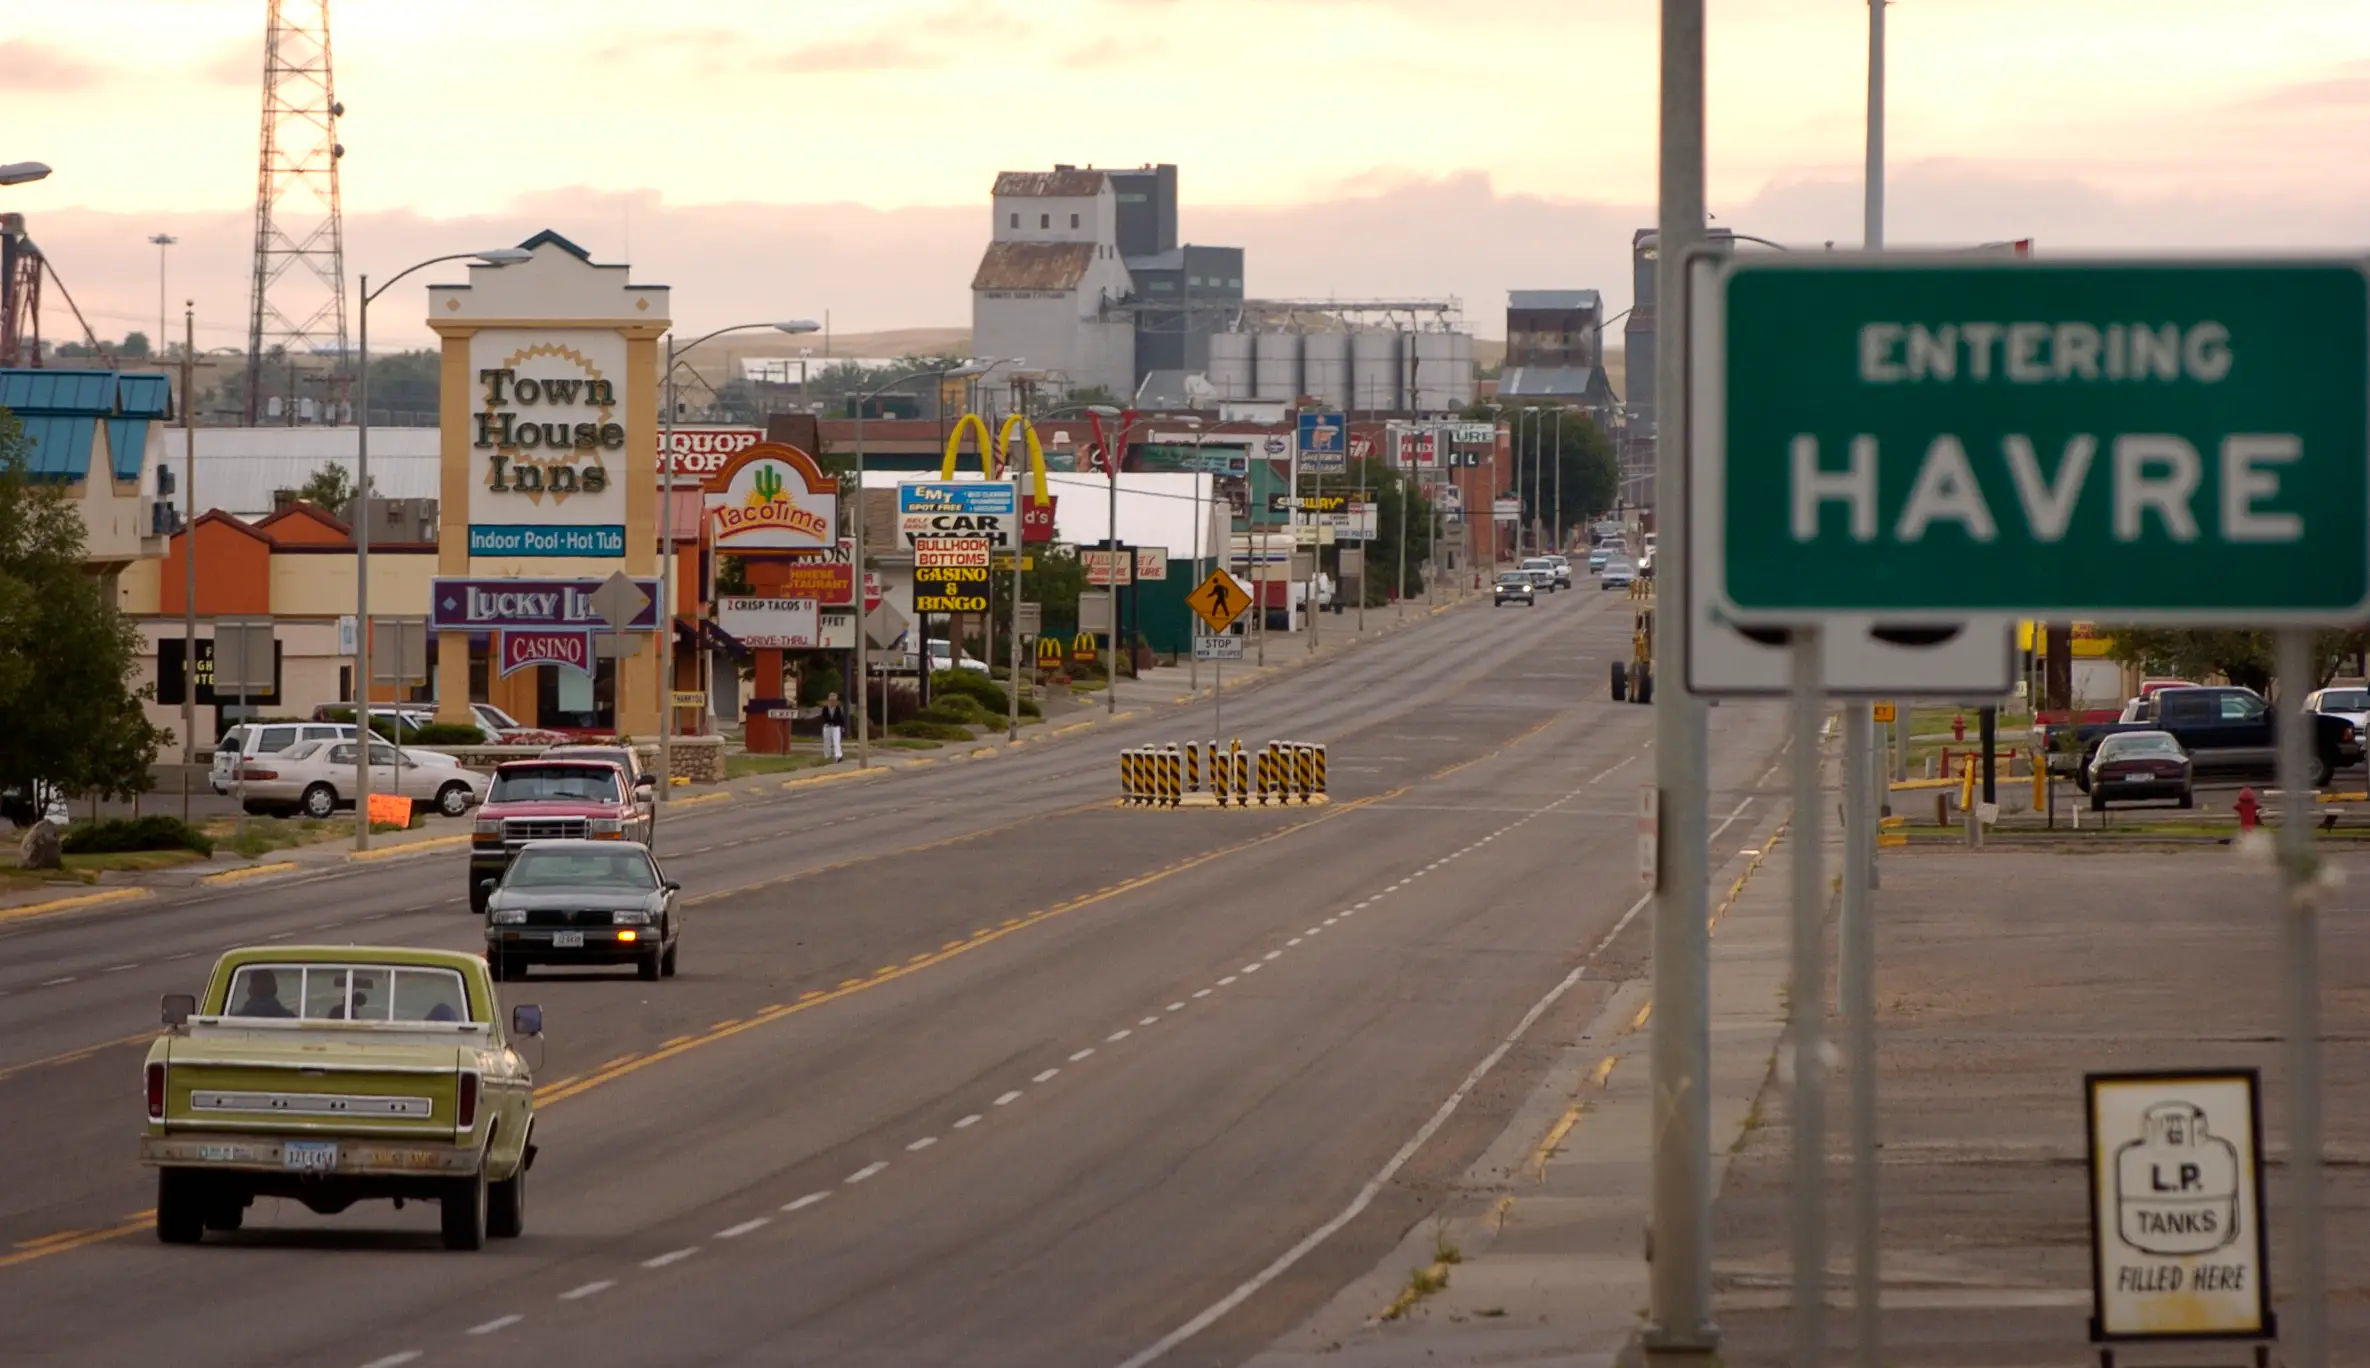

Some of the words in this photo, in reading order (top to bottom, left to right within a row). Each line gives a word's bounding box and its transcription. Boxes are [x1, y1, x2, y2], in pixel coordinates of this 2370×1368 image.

[1858, 322, 2233, 382] ENTERING
[480, 369, 616, 405] Town
[474, 413, 624, 450] House
[490, 456, 605, 492] Inns
[914, 485, 953, 503] EMT
[1789, 433, 2304, 543] HAVRE
[712, 500, 827, 533] TacoTime
[932, 516, 999, 530] CAR
[471, 531, 521, 549] Indoor
[596, 532, 622, 549] Tub
[916, 539, 988, 551] BULLHOOK
[919, 553, 986, 565] BOTTOMS
[915, 568, 988, 581] CASINO
[944, 582, 958, 595] &
[466, 586, 559, 620] LUCKY
[735, 600, 765, 611] CRISP
[768, 600, 800, 611] TACOS
[917, 597, 987, 611] BINGO
[513, 638, 581, 663] CASINO
[1205, 639, 1232, 649] STOP
[2152, 1162, 2204, 1192] L.P.
[2136, 1209, 2218, 1235] TANKS
[2117, 1265, 2184, 1292] FILLED
[2191, 1263, 2246, 1292] HERE
